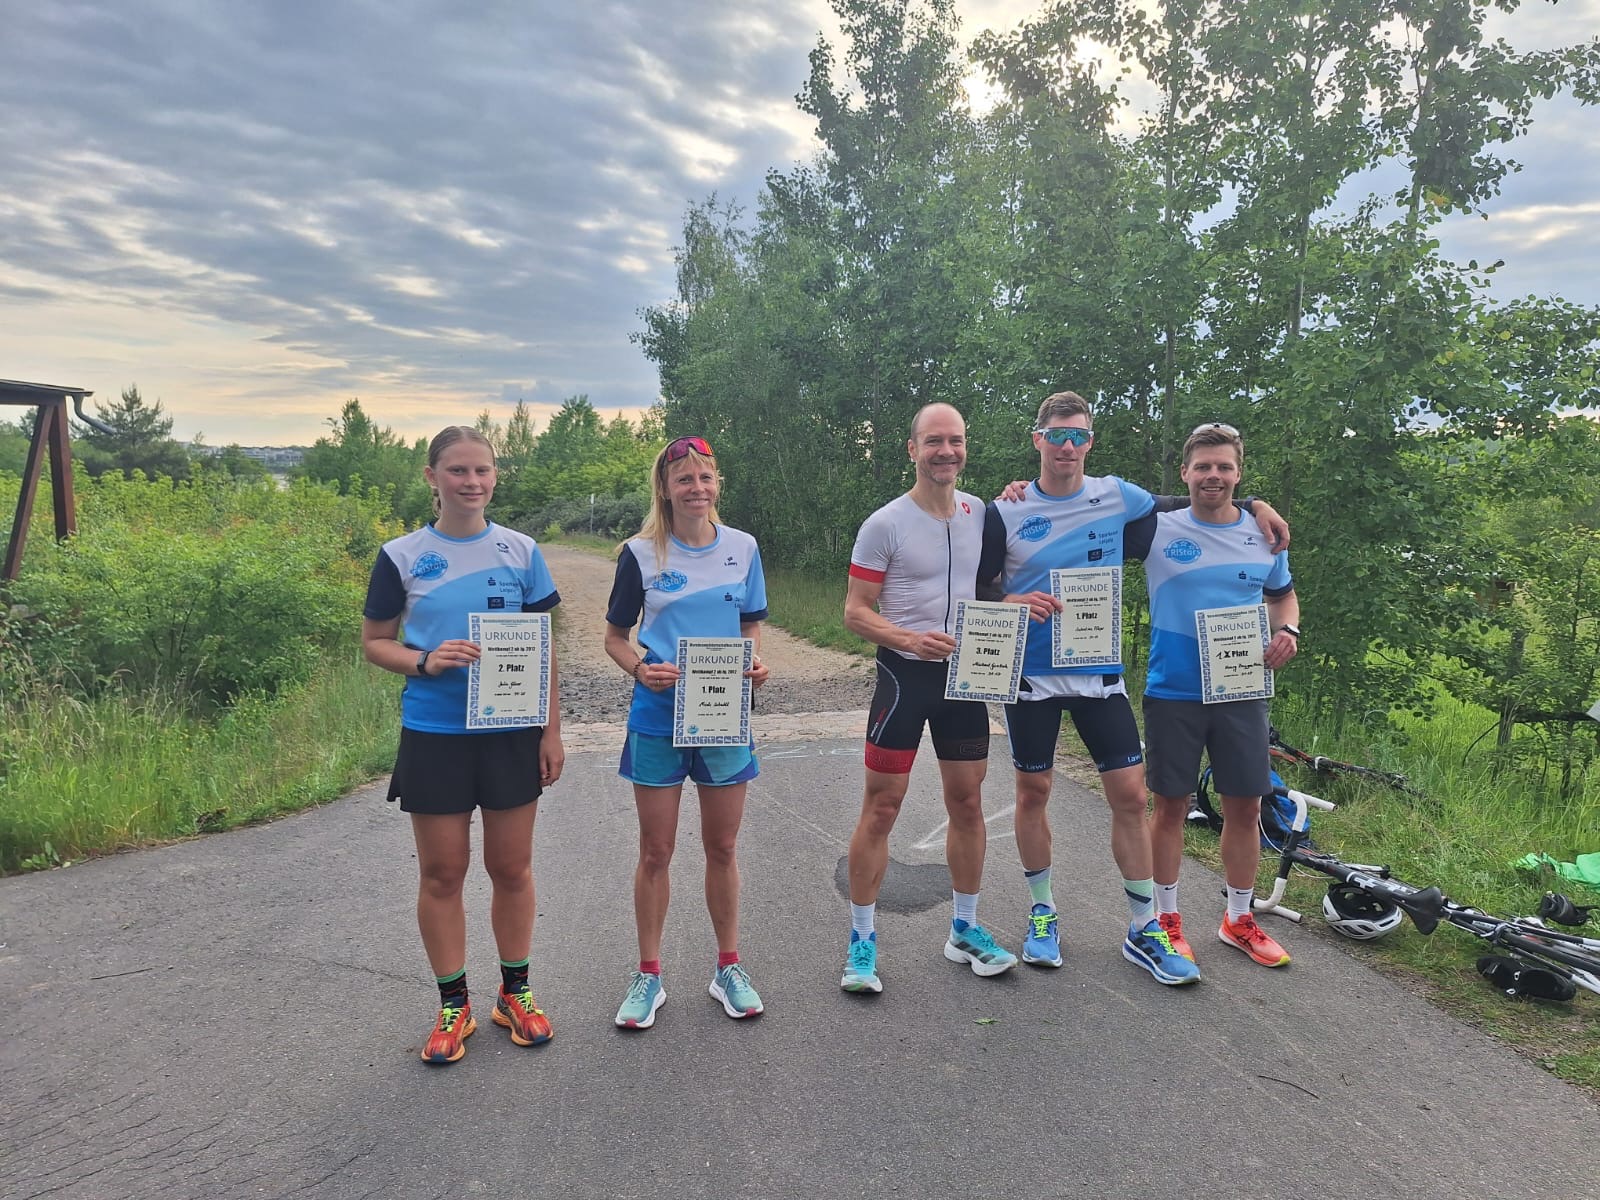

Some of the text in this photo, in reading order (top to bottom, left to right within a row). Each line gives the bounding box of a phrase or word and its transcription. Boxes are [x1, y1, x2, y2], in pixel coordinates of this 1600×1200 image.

[1164, 549, 1202, 557] TRIStars
[1064, 584, 1109, 593] URKUNDE
[968, 618, 1014, 628] URKUNDE
[1210, 621, 1256, 632] URKUNDE
[485, 632, 536, 640] URKUNDE
[984, 648, 1000, 656] Platz
[690, 656, 739, 664] URKUNDE
[498, 664, 525, 672] 2. Platz
